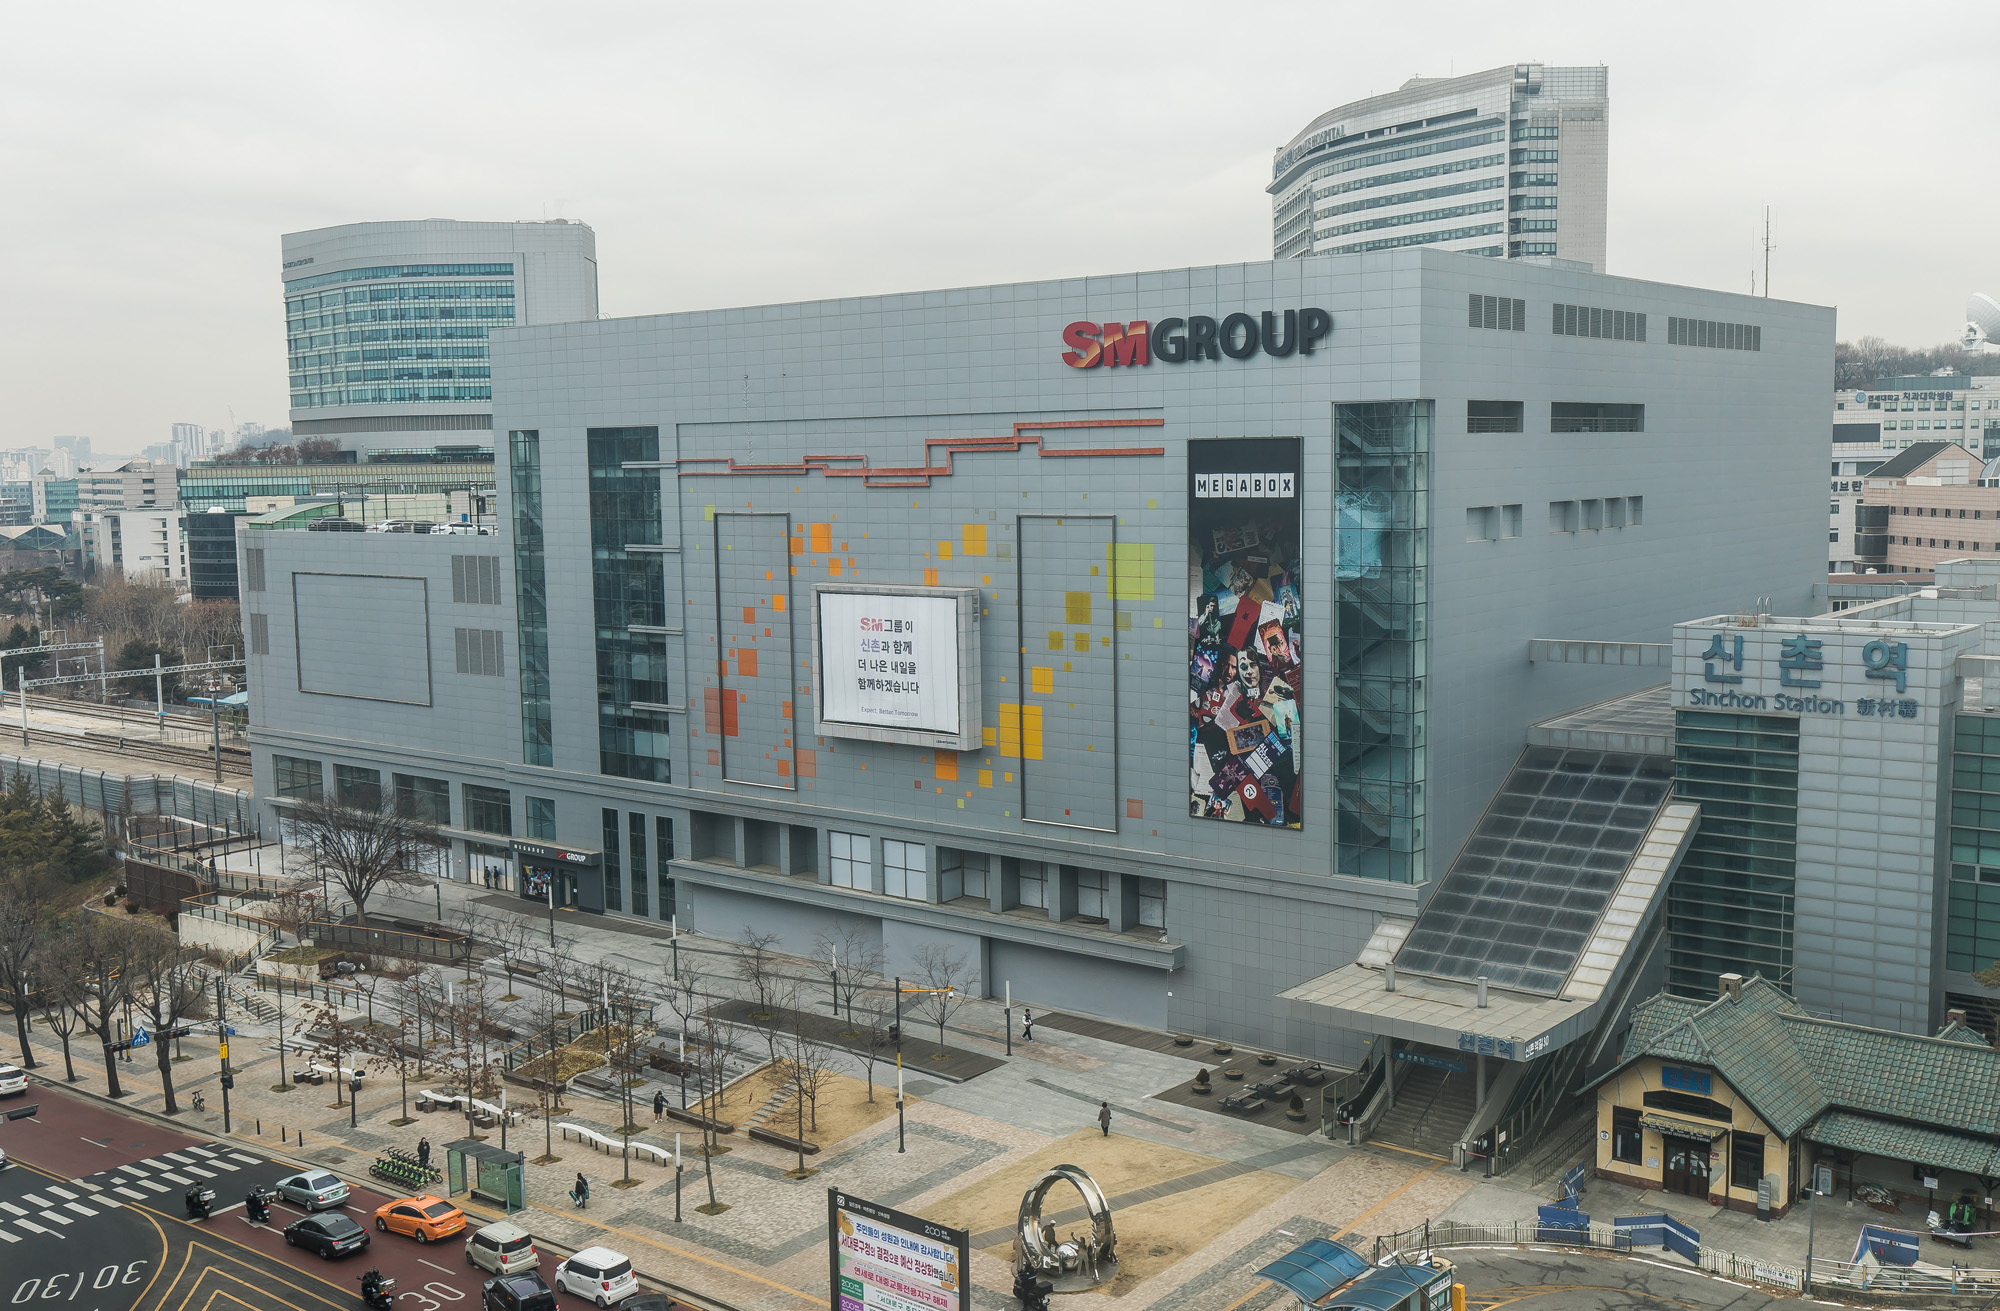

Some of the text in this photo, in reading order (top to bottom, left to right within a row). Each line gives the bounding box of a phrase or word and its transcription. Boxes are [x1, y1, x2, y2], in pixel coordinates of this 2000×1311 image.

[1867, 391, 1954, 402] 연세대학교 치과대학병원
[1196, 478, 1292, 493] MEGABOX
[861, 638, 913, 655] 신촌과 함께
[858, 659, 917, 675] 더 나은 내일을
[1702, 634, 1908, 694] 신촌역
[858, 677, 920, 695] 함께하겠습니다
[1689, 688, 1844, 714] Sinchon Station
[1255, 747, 1274, 768] ACCESS
[1259, 743, 1269, 753] ALL
[1458, 1032, 1514, 1059] 신촌역
[856, 1222, 880, 1239] 주민들의
[881, 1231, 900, 1246] 성원과
[900, 1237, 920, 1252] 인내에
[841, 1234, 876, 1257] 서대문구청의
[876, 1246, 899, 1266] 결정으로
[900, 1254, 913, 1271] 예산
[398, 1281, 466, 1311] 30
[854, 1266, 875, 1281] 연세로
[875, 1273, 932, 1302] 대중교통전용지구
[932, 1295, 948, 1309] 해제
